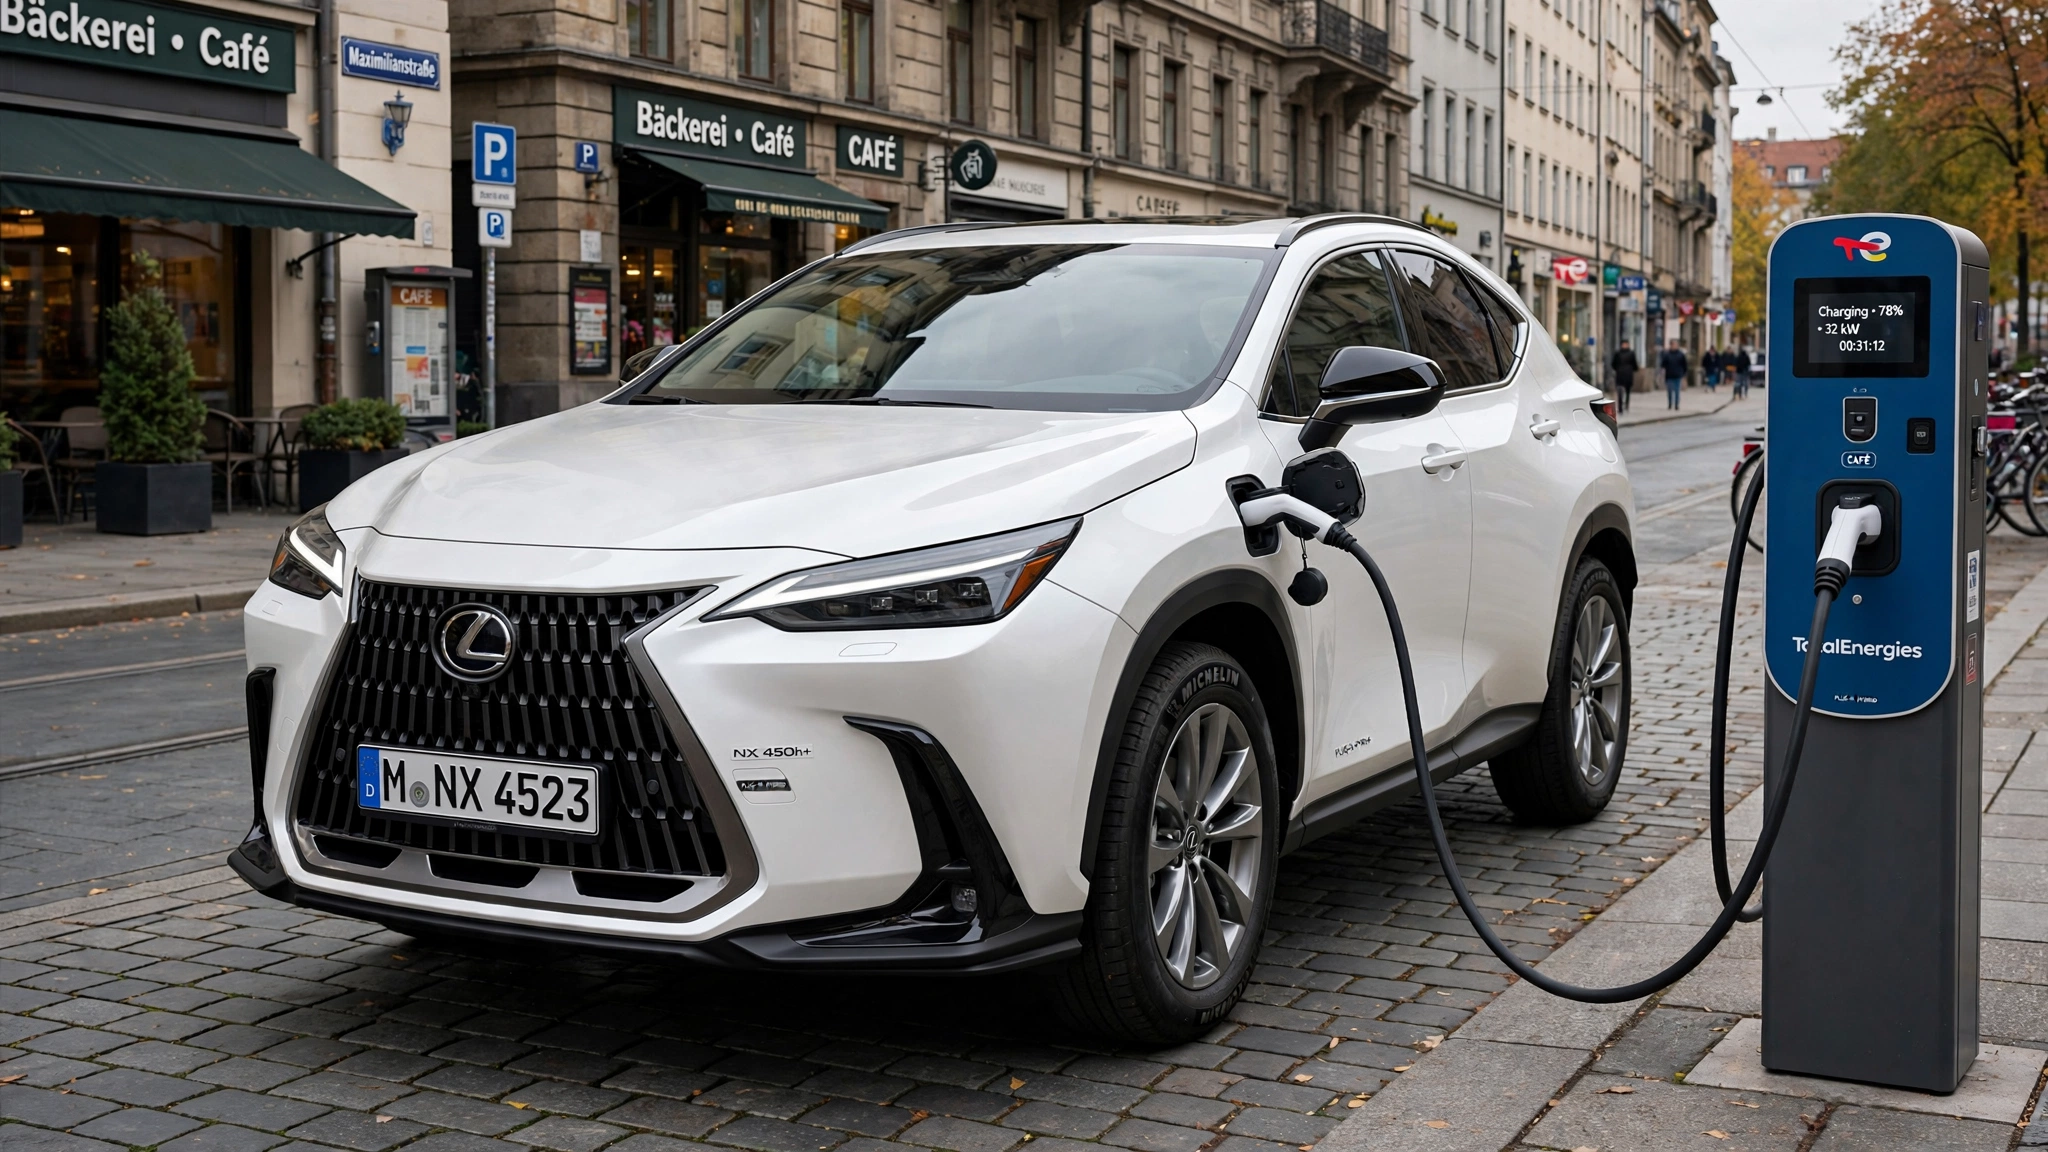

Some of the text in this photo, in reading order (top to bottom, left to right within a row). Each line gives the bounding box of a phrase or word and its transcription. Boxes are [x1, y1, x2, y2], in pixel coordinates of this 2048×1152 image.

[0, 0, 155, 56] Bäckerei
[199, 26, 270, 74] Café
[348, 46, 436, 79] Maximilianstraße
[636, 100, 727, 148] Bäckerei
[751, 120, 795, 158] Café
[484, 132, 508, 176] P
[848, 134, 897, 171] CAFÉ
[1818, 305, 1869, 320] Charging
[1878, 304, 1904, 316] 78%
[1824, 323, 1838, 335] 32
[1840, 323, 1860, 335] kW
[1839, 340, 1885, 352] 00:31:12
[1792, 636, 1923, 661] TalEnergies
[1181, 666, 1240, 704] MICHELIN
[733, 747, 812, 758] NX 450h+
[365, 783, 375, 797] D
[383, 758, 589, 823] M NX 4523
